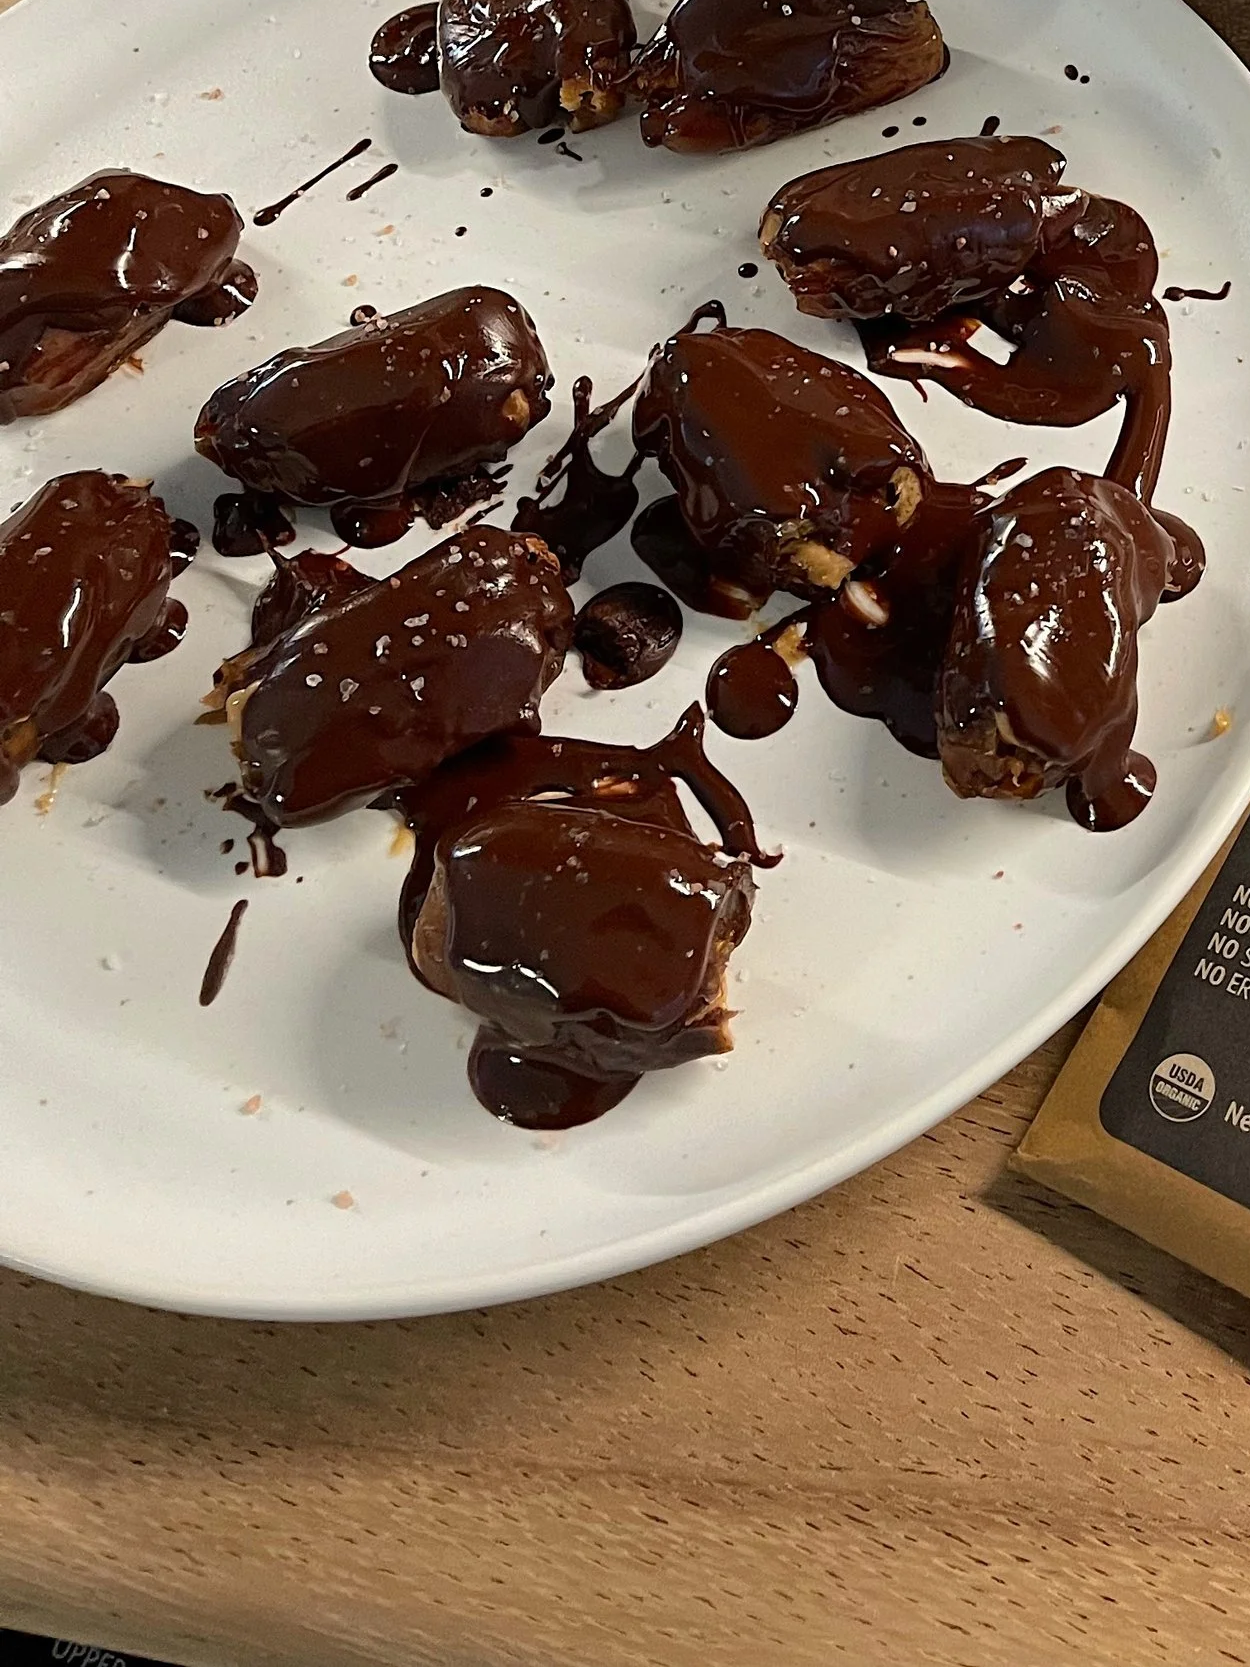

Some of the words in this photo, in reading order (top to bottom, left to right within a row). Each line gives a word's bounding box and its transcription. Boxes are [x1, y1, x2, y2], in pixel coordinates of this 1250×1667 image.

[1207, 932, 1240, 959] NO
[1194, 958, 1226, 986] NO
[1168, 1063, 1205, 1093] USDA
[1155, 1080, 1202, 1111] ORGANIC
